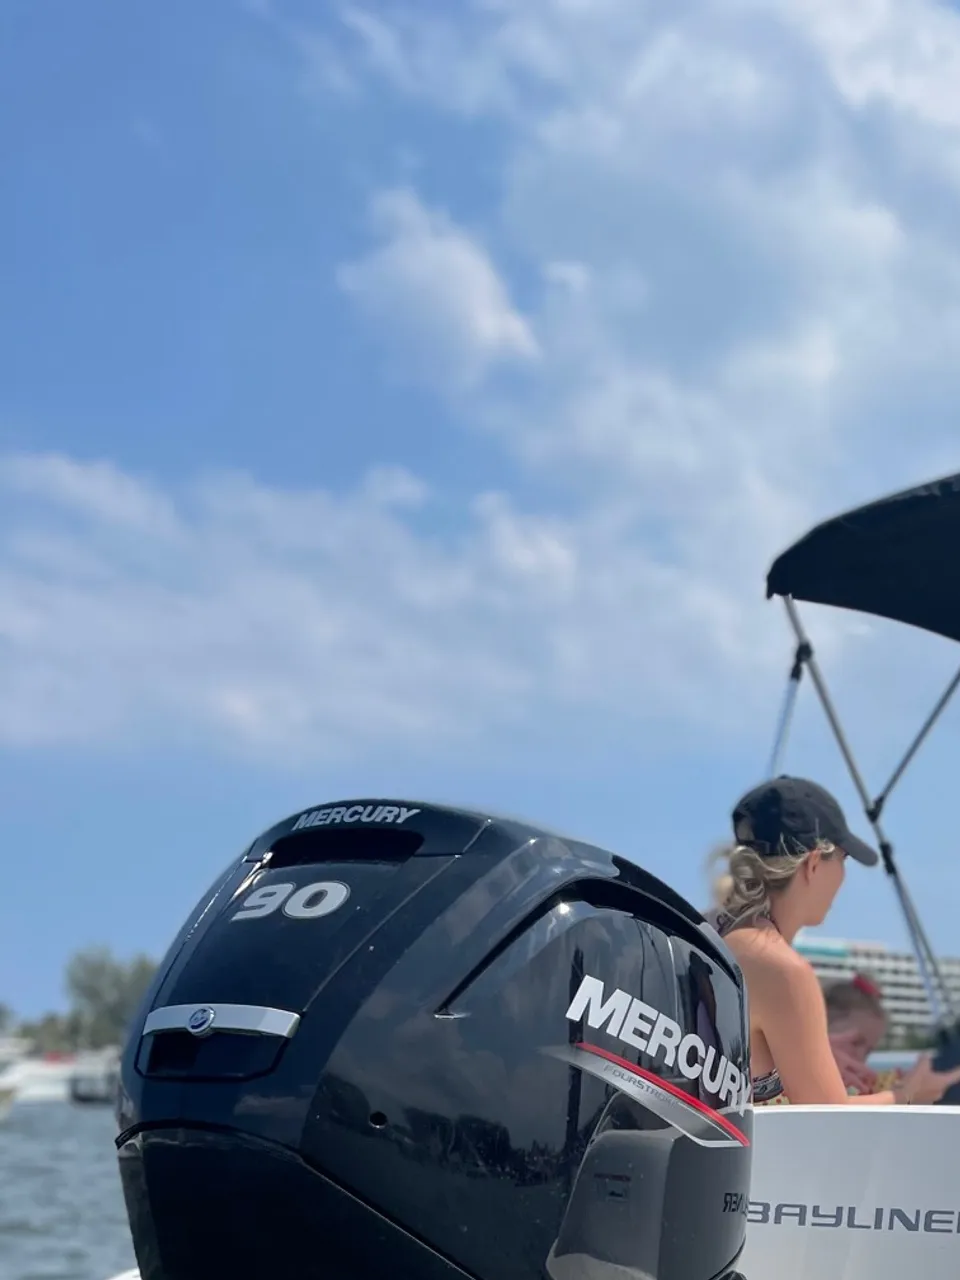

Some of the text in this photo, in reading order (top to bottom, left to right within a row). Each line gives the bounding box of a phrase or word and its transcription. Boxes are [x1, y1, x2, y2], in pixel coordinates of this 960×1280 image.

[292, 805, 421, 831] MERCURY
[231, 880, 350, 921] 90
[565, 974, 752, 1117] MERCURY
